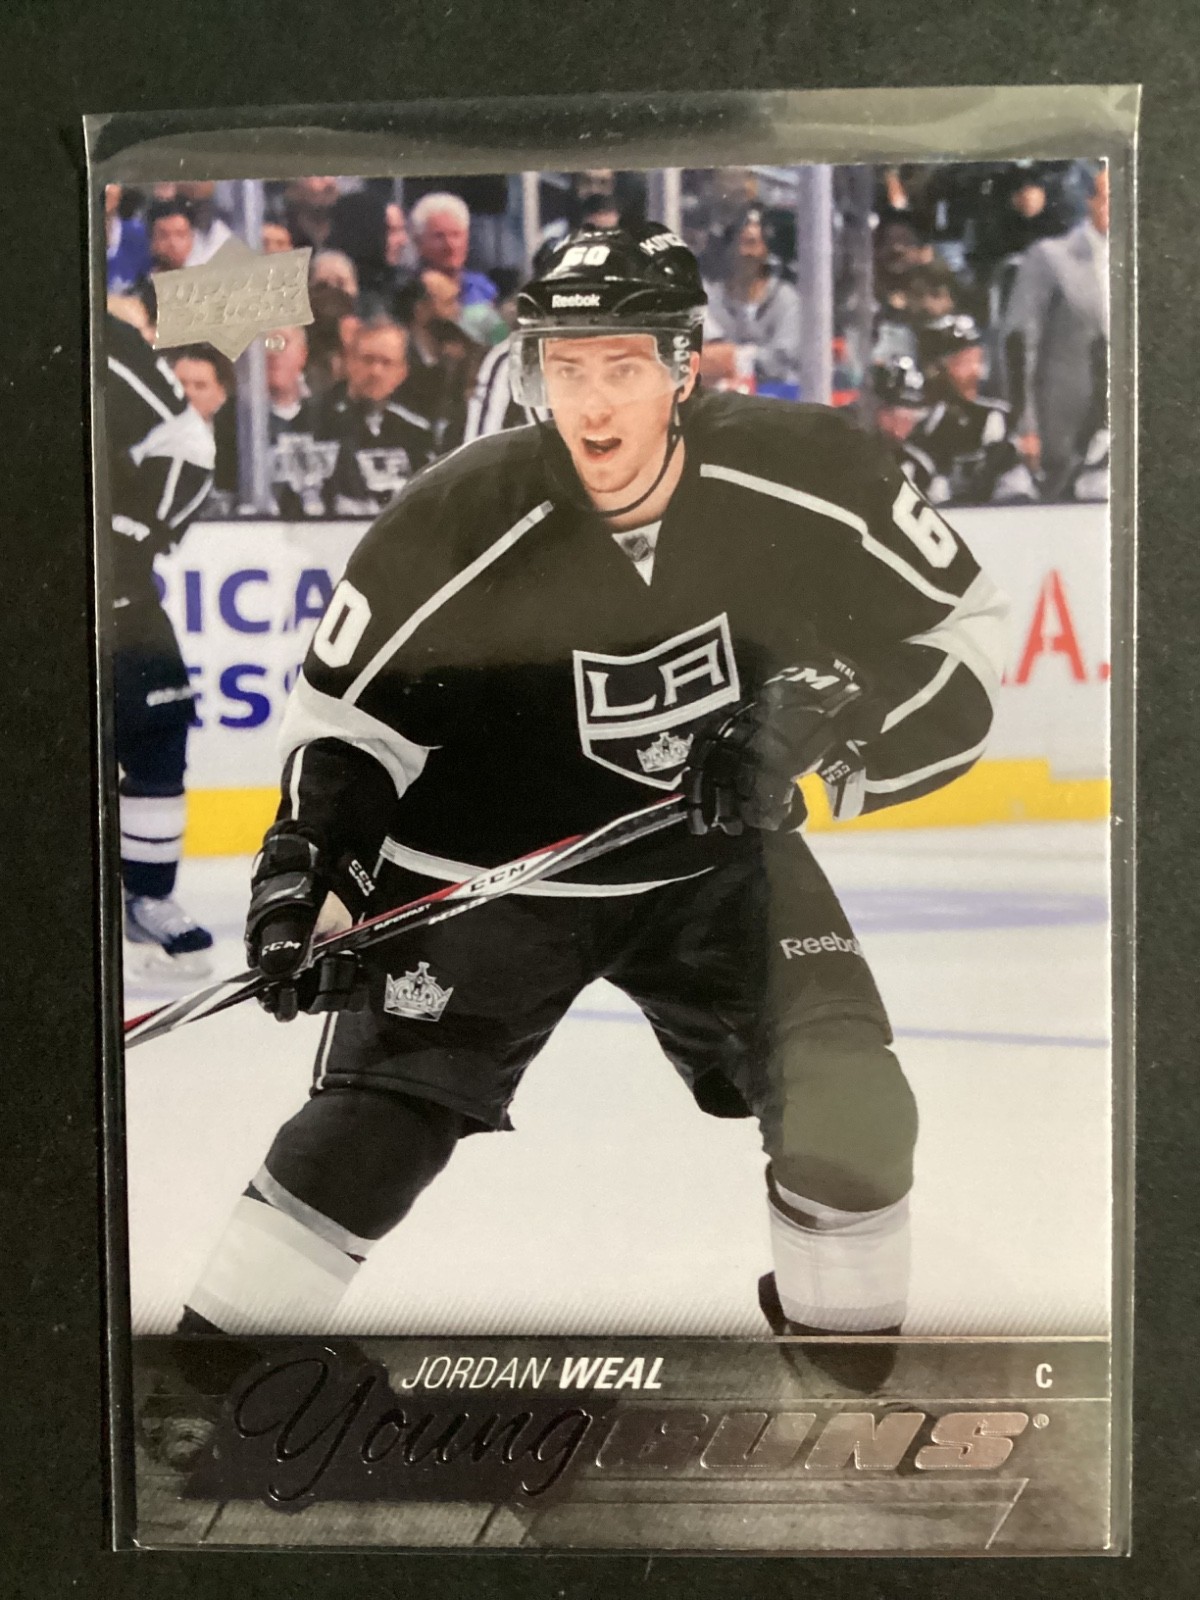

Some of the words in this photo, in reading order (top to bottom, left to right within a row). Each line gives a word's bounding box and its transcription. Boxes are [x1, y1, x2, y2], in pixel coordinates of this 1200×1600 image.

[551, 293, 601, 309] Reebok
[154, 568, 334, 634] ICA
[585, 638, 726, 718] LA
[469, 862, 526, 893] CCM
[779, 931, 865, 960] Reebo
[401, 1356, 552, 1390] JORDAN
[558, 1357, 665, 1390] WEAL
[1036, 1364, 1053, 1389] C
[234, 1358, 594, 1502] Young
